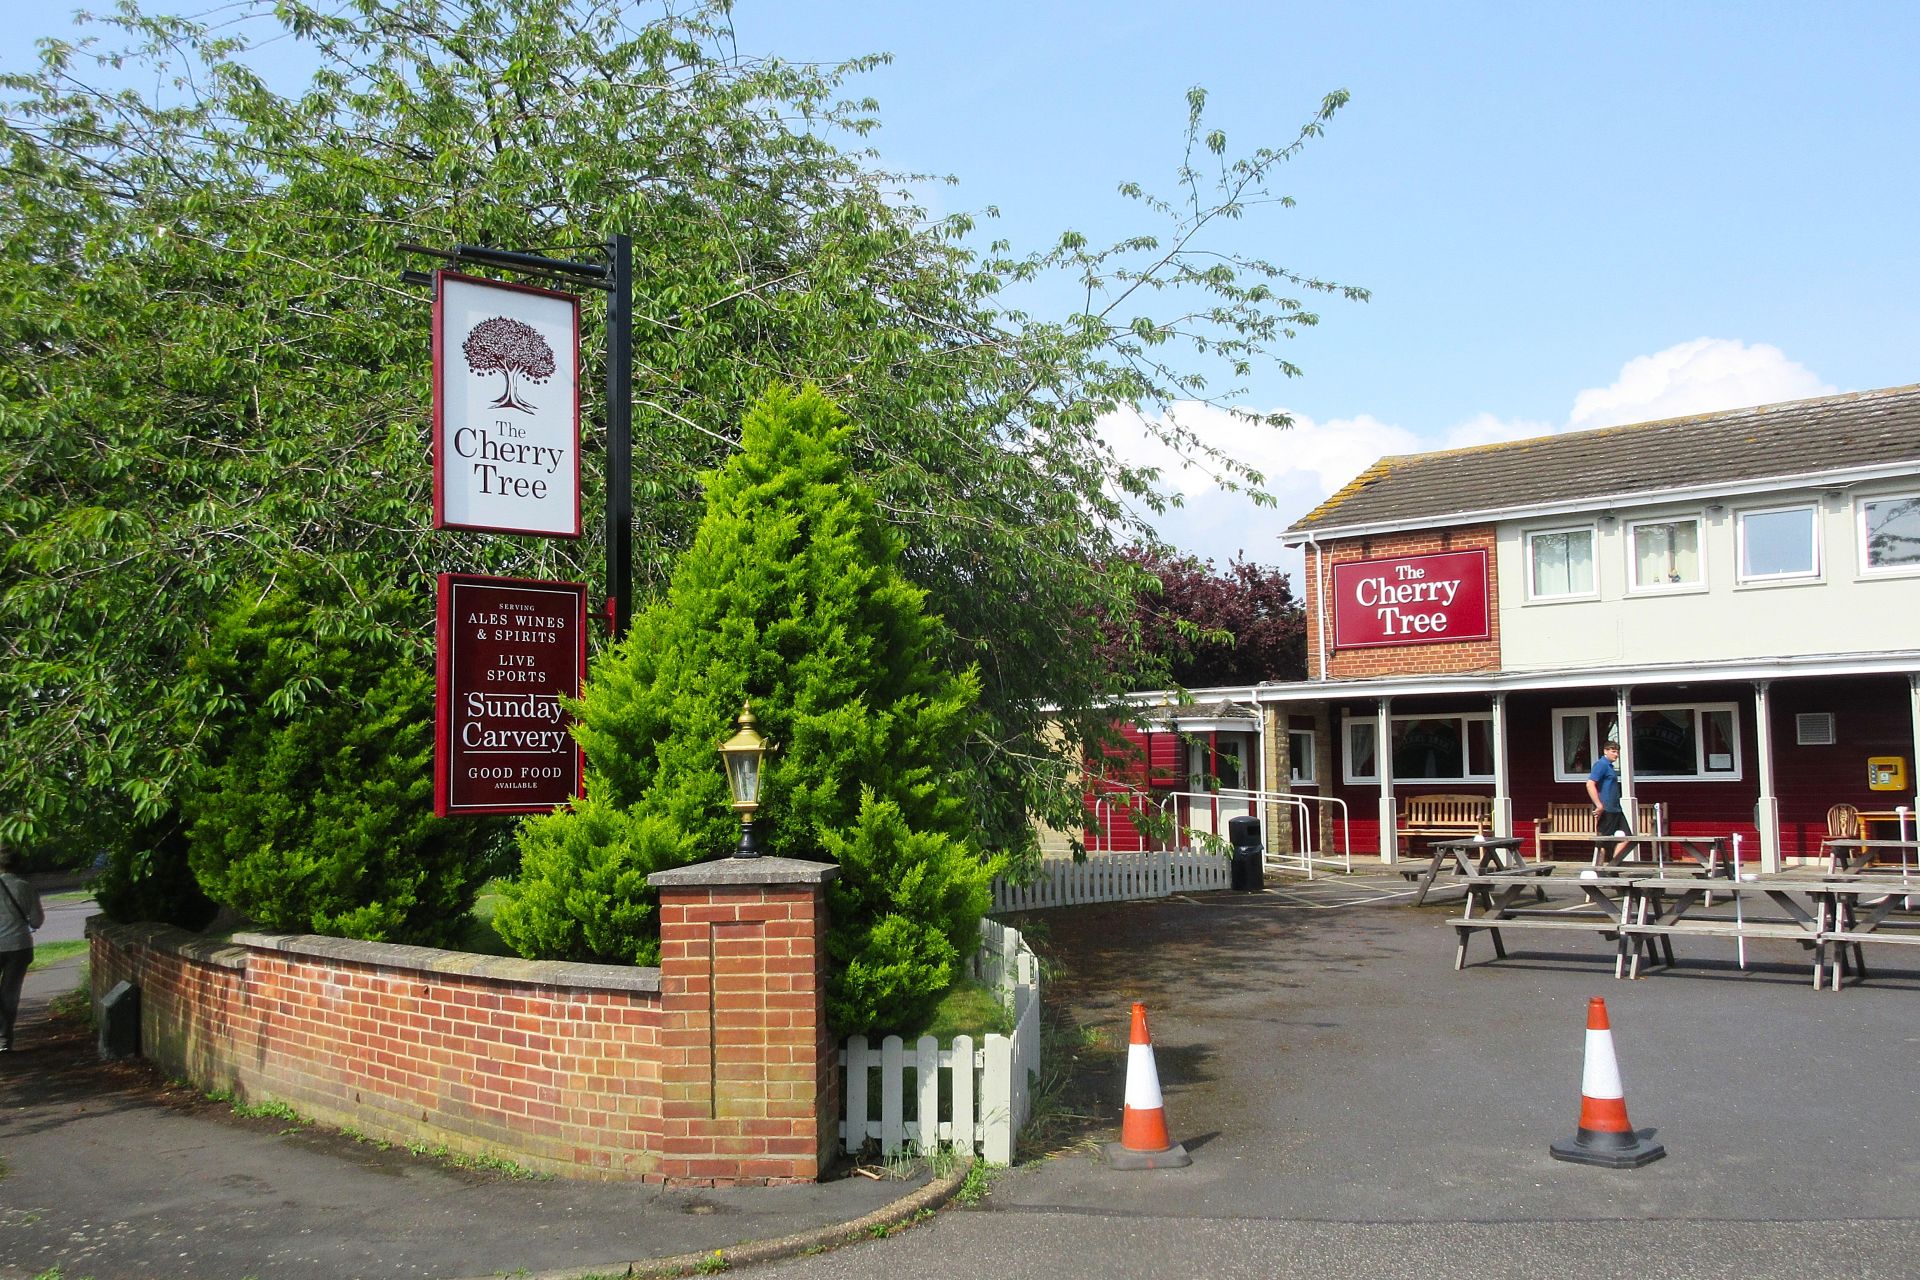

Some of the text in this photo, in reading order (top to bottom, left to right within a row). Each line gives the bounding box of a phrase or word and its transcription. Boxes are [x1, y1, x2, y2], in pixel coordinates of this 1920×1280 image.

[495, 420, 527, 439] The
[454, 427, 565, 474] Cherry
[474, 464, 548, 499] Tree
[1395, 565, 1425, 580] The
[1355, 577, 1461, 607] Cherry
[499, 603, 535, 611] SERVING
[468, 612, 565, 628] ALES WINES
[1377, 607, 1448, 635] Tree
[476, 628, 557, 643] & SPIRITS
[499, 655, 535, 667] LIVE
[487, 670, 547, 683] SPORTS
[467, 691, 564, 724] Sunday
[462, 722, 567, 753] Carvery
[468, 767, 562, 779] GOOD FOOD
[494, 781, 538, 789] AVAILABLE
